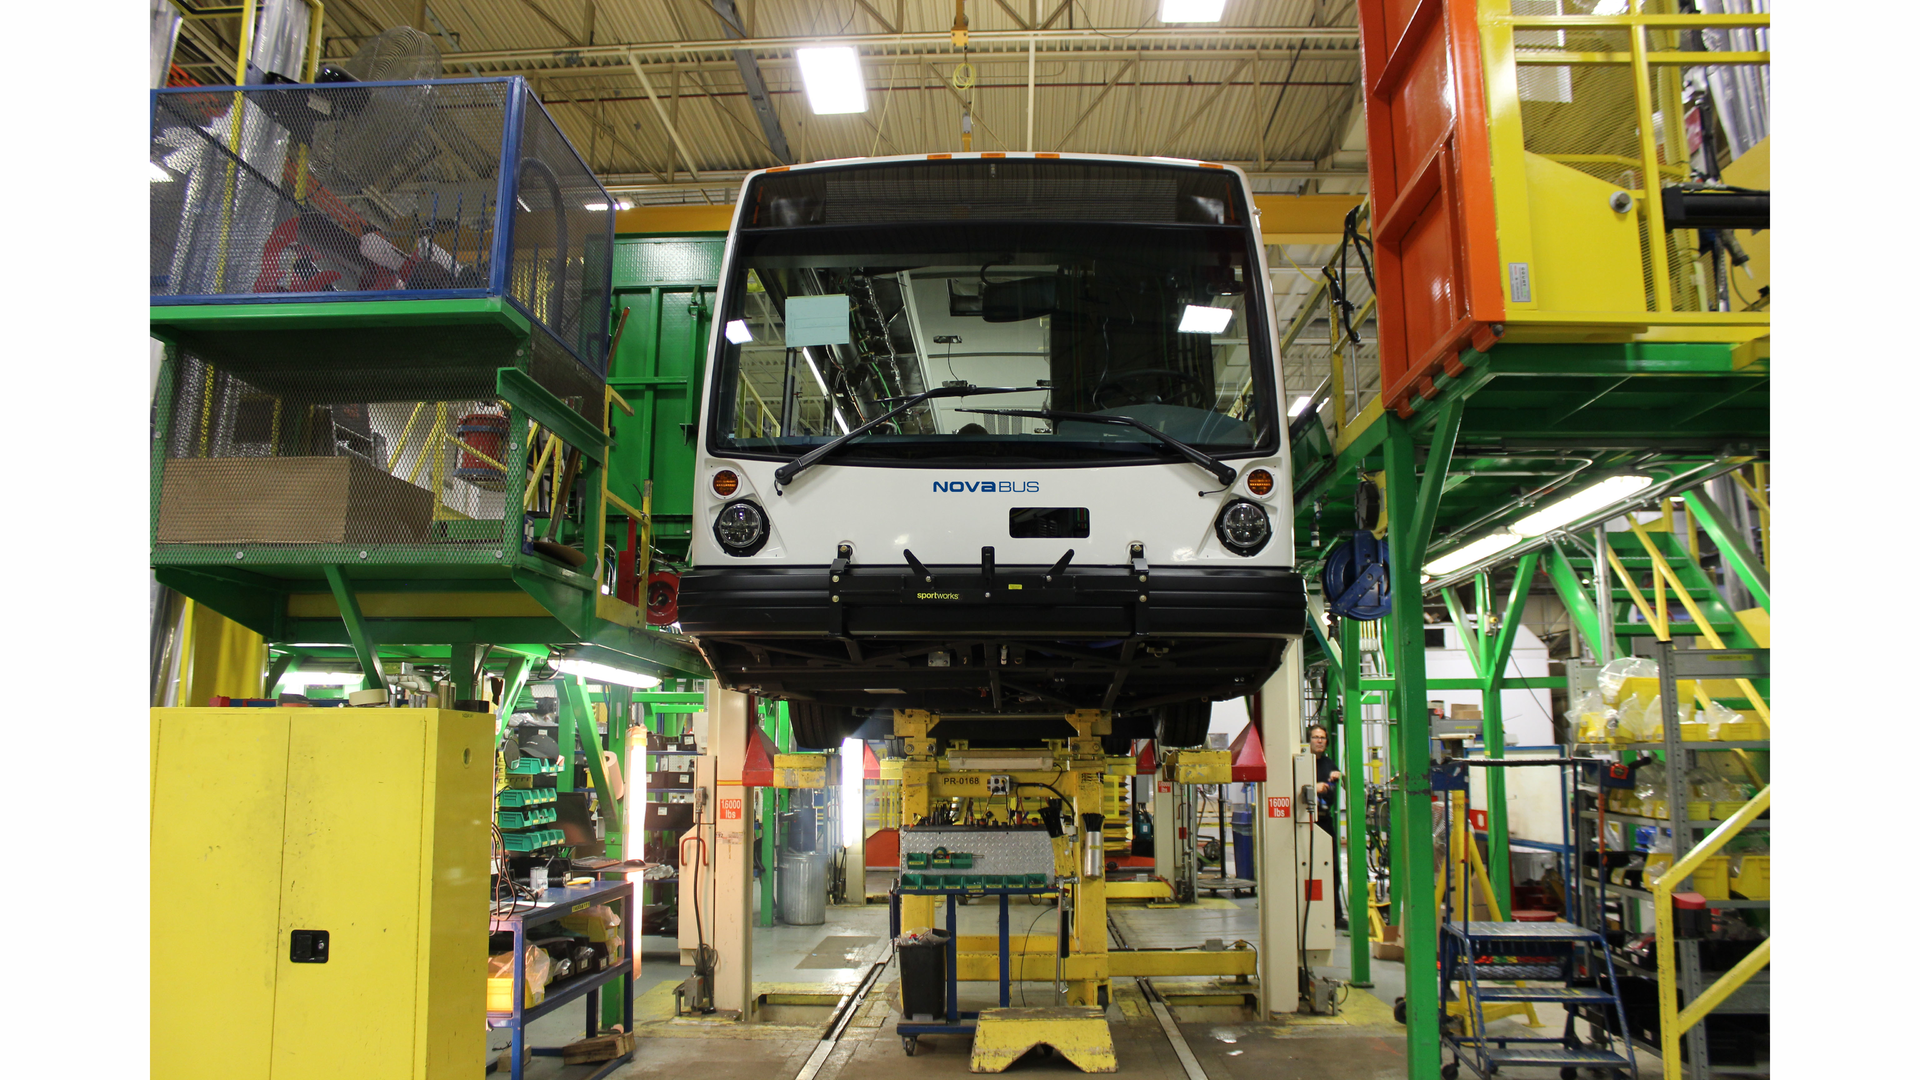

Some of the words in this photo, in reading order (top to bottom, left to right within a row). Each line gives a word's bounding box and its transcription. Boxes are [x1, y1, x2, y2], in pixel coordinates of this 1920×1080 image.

[917, 592, 960, 600] sportworks
[943, 777, 980, 785] PR-0168
[721, 800, 741, 810] 16000
[1269, 798, 1290, 808] 16000
[725, 809, 737, 819] lbs
[1274, 808, 1286, 817] lbs
